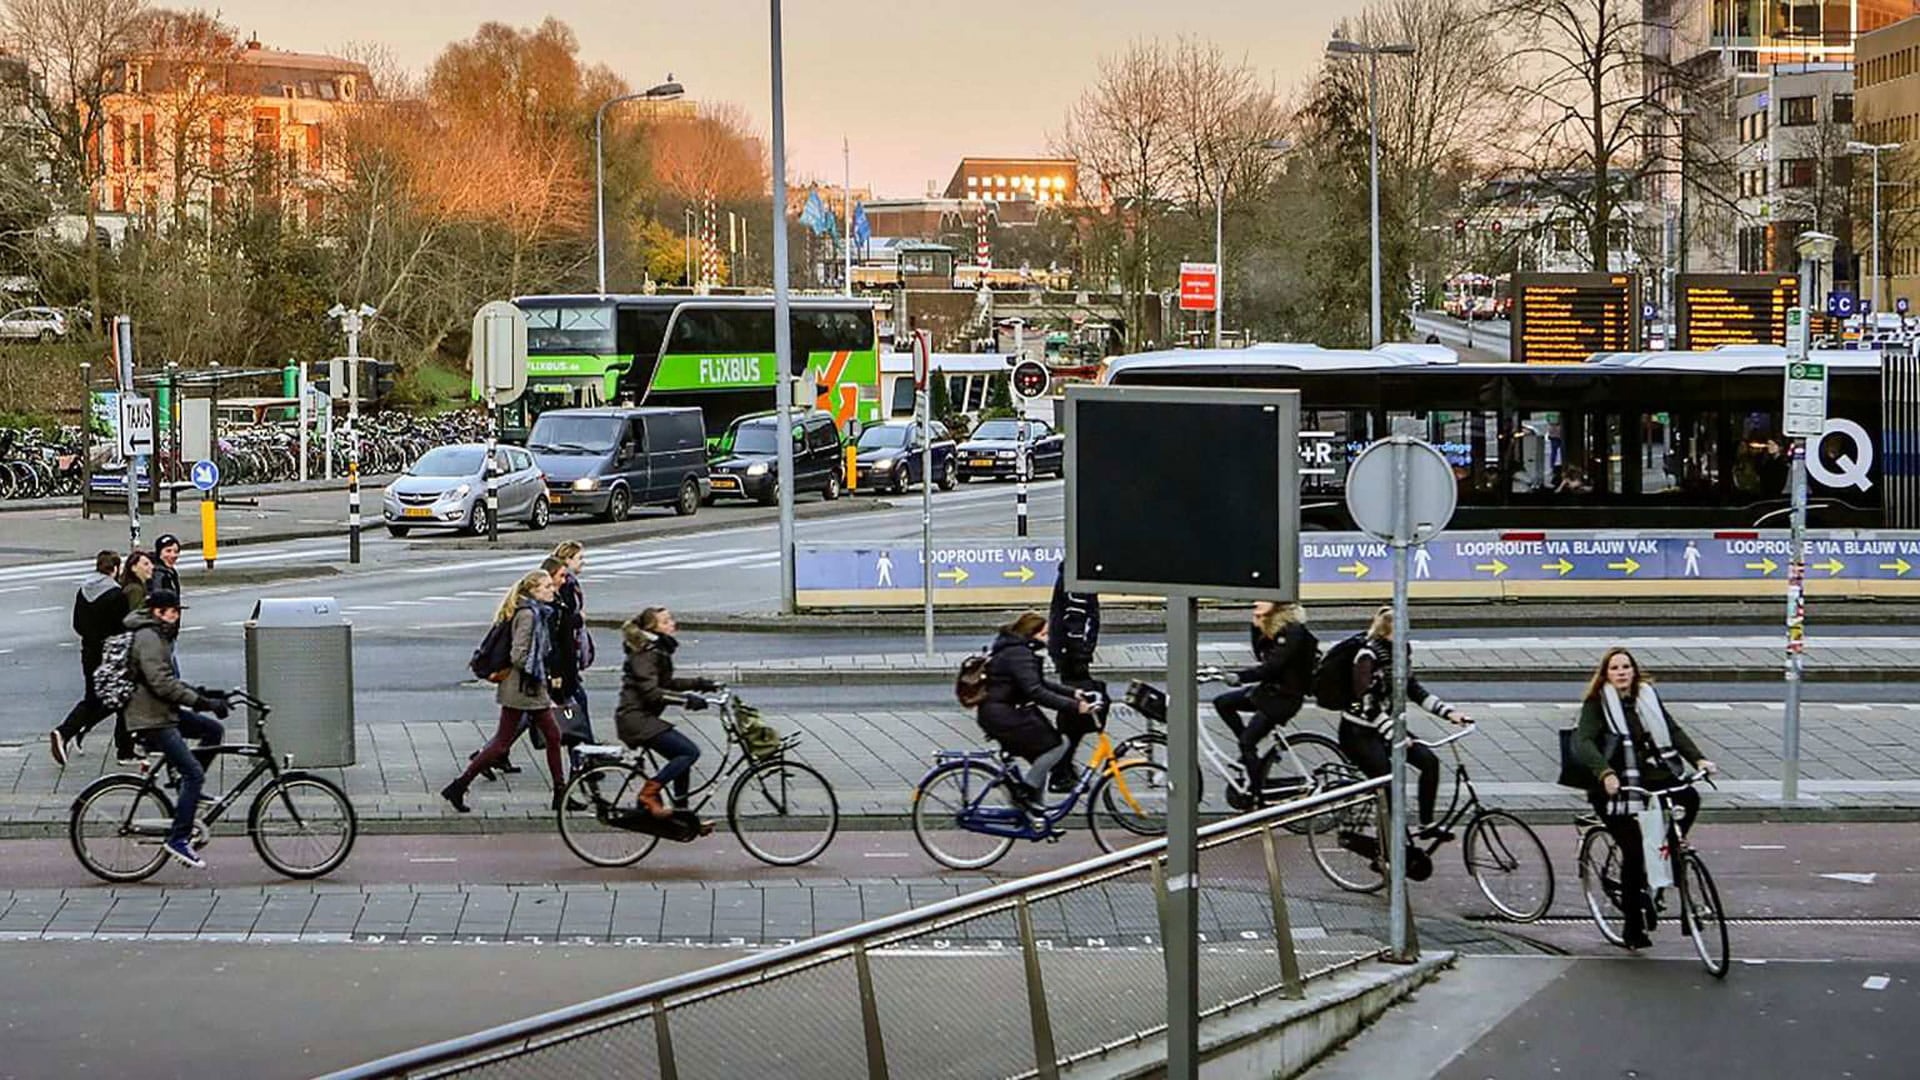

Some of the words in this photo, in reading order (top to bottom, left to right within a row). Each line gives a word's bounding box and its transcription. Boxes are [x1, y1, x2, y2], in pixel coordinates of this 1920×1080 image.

[1839, 298, 1851, 311] C
[1298, 442, 1332, 463] +R
[1805, 418, 1873, 492] Q
[1007, 548, 1031, 562] VIA
[1035, 548, 1066, 561] BLA
[1303, 544, 1354, 558] BLAUW
[1356, 543, 1388, 557] VAK
[1456, 542, 1542, 555] LOOPROUTE
[1546, 541, 1570, 555] VIA
[1573, 541, 1625, 555] BLAUW
[1627, 540, 1658, 554] VAK
[1726, 540, 1813, 554] LOOPROUE
[1816, 541, 1843, 554] VIA
[1845, 541, 1897, 555] BLAUW
[1899, 541, 1920, 555] VA
